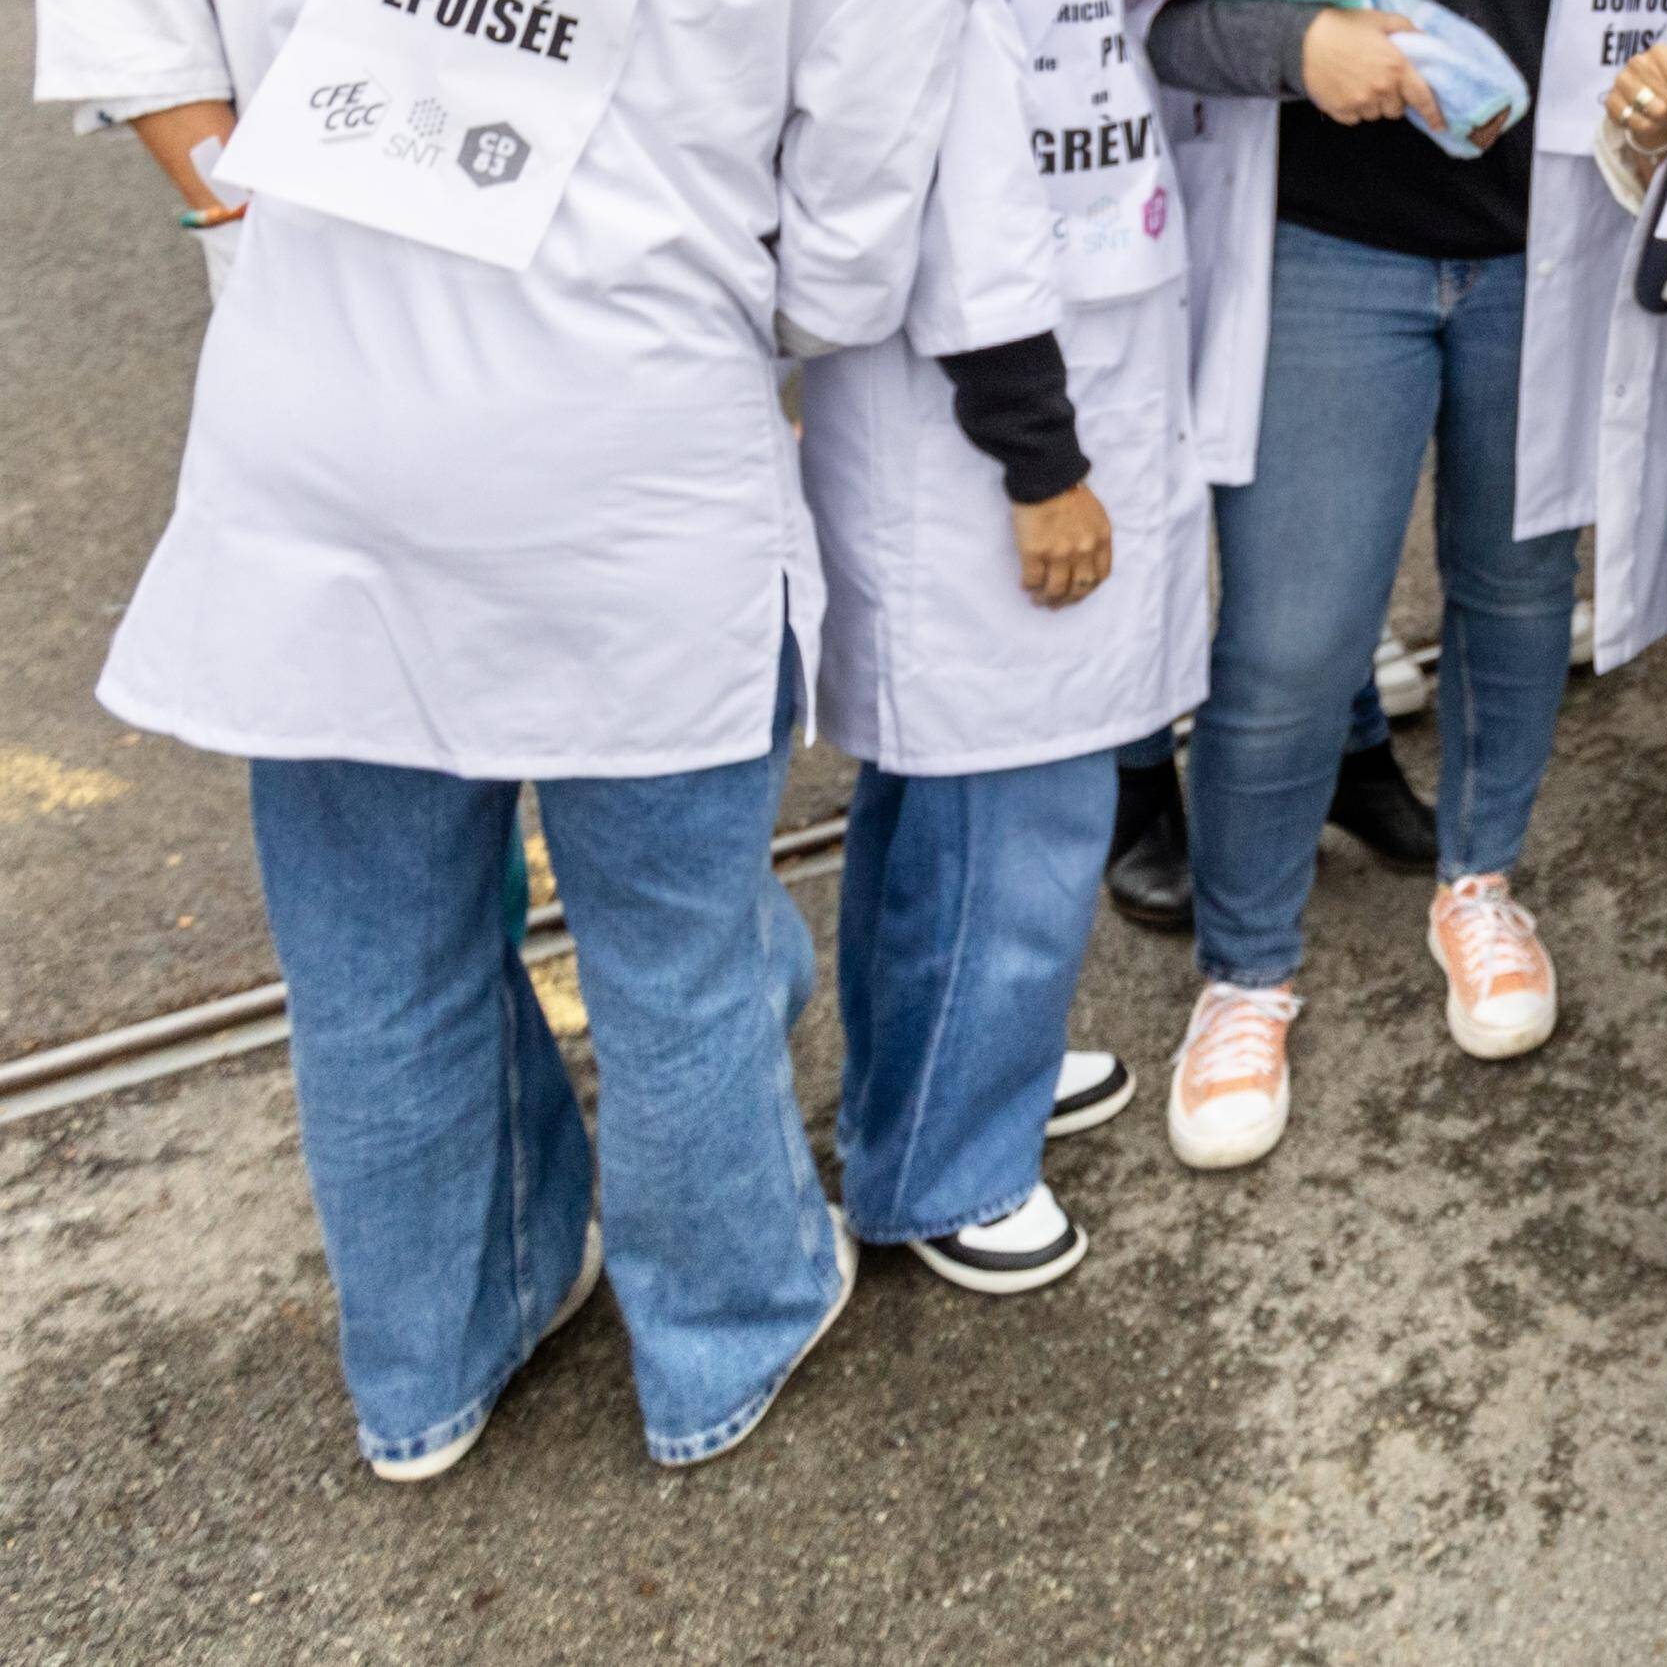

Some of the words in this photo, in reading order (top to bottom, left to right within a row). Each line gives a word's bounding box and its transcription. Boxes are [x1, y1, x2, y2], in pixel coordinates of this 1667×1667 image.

[309, 79, 368, 111] CFE
[324, 101, 384, 132] CGC
[382, 137, 447, 170] SNT
[477, 131, 515, 157] CD
[473, 150, 508, 178] 83
